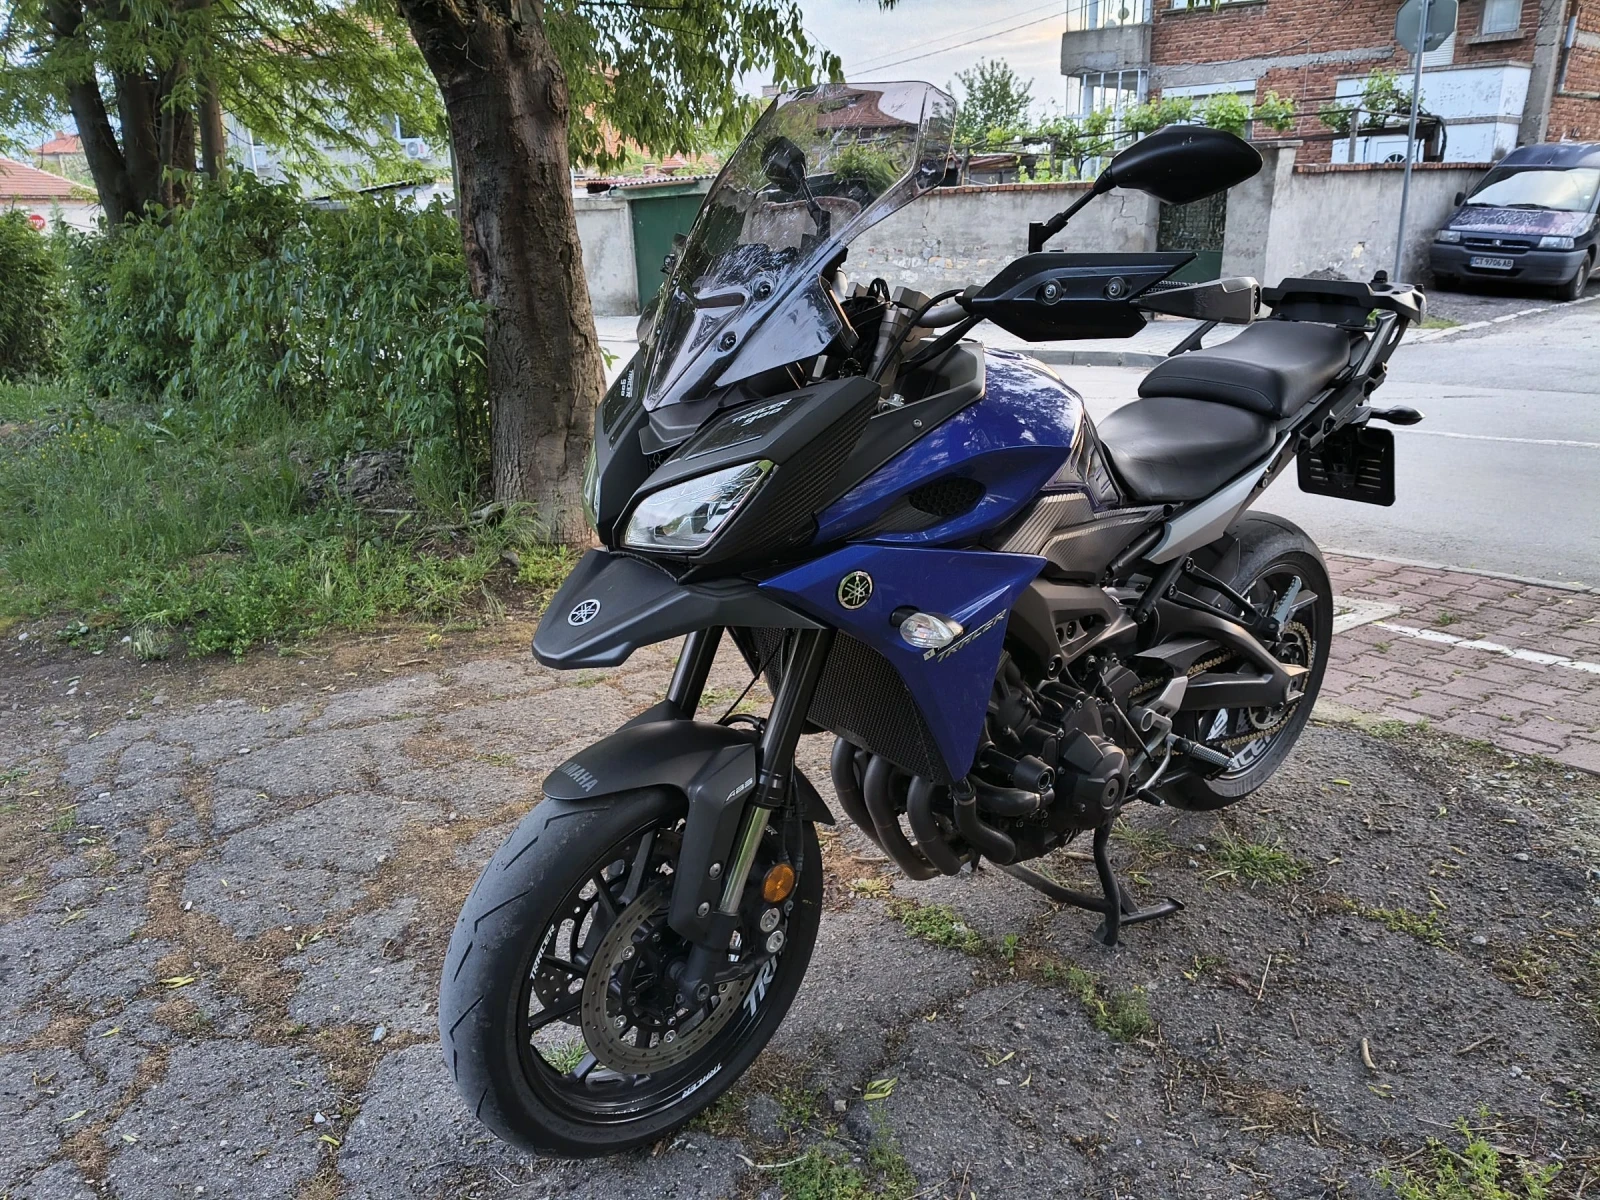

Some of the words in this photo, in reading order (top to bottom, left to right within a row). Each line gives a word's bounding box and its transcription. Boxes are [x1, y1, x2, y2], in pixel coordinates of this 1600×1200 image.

[1475, 257, 1484, 265] CT
[1485, 258, 1501, 266] 9706
[1502, 260, 1512, 268] AB
[626, 369, 634, 398] TRACER
[731, 398, 792, 423] TRACER
[936, 608, 1007, 663] TRACER
[558, 760, 599, 792] YAMAHA
[725, 777, 753, 802] ABS
[529, 923, 556, 980] TRACER
[681, 1062, 723, 1099] TRACER
